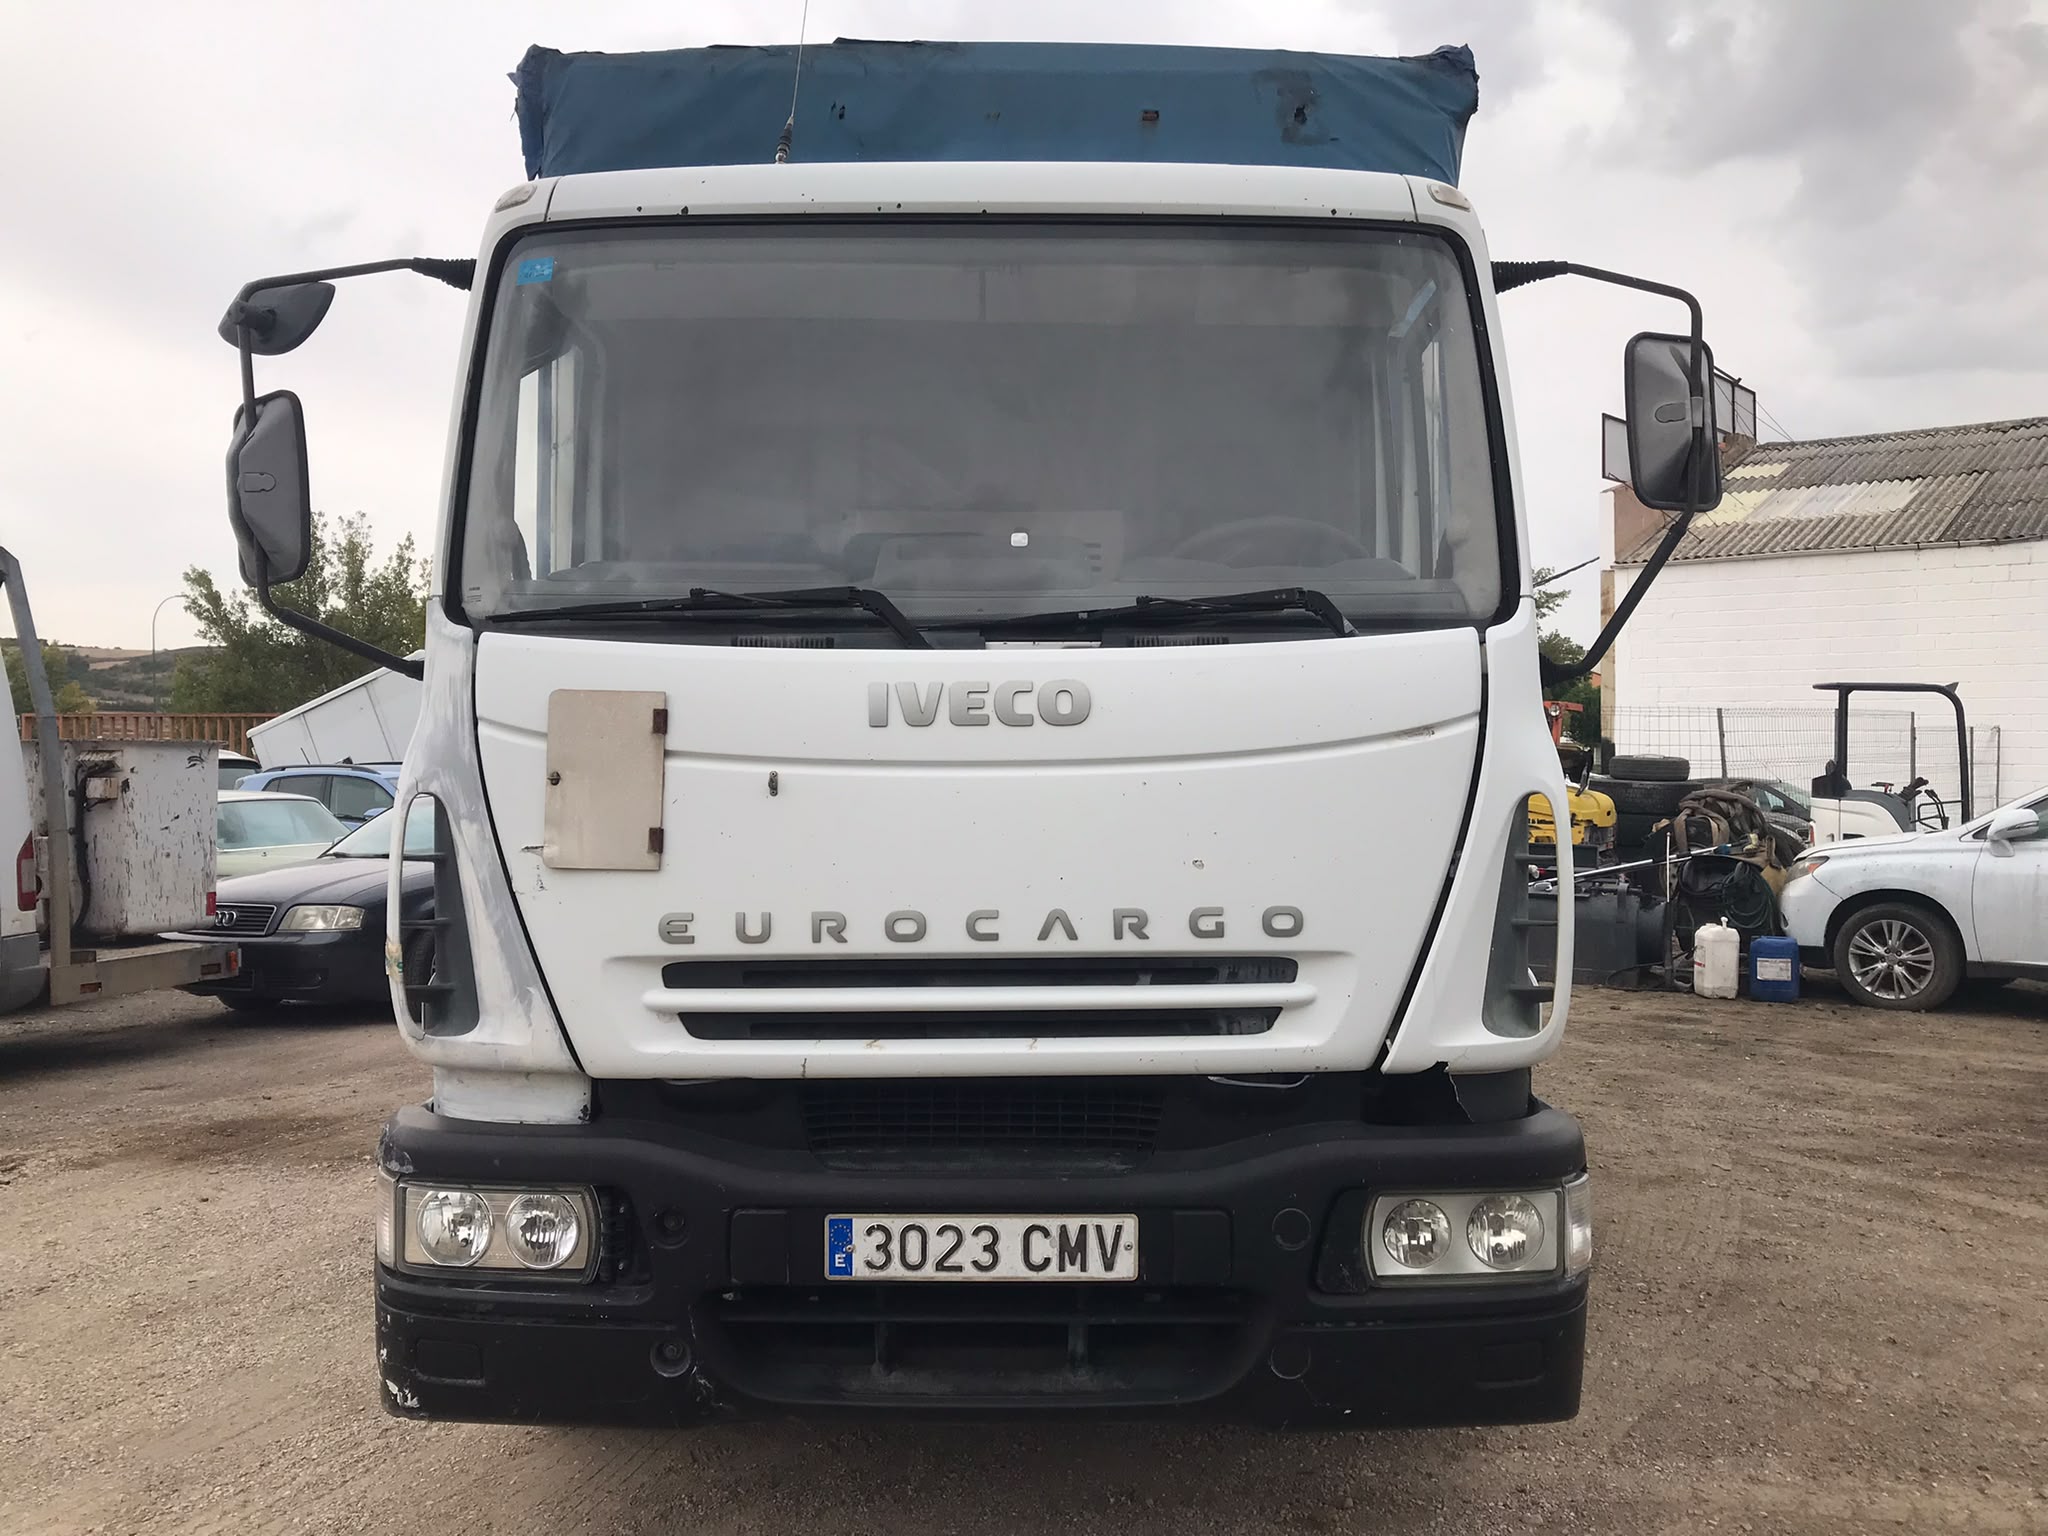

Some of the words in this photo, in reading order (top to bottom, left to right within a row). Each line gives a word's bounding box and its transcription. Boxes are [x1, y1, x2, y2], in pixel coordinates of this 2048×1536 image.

[868, 679, 1092, 728] IVECO
[657, 905, 1305, 945] EUROCARGO
[834, 1253, 846, 1268] E
[863, 1223, 1001, 1273] 3023
[1022, 1223, 1124, 1273] CMV
